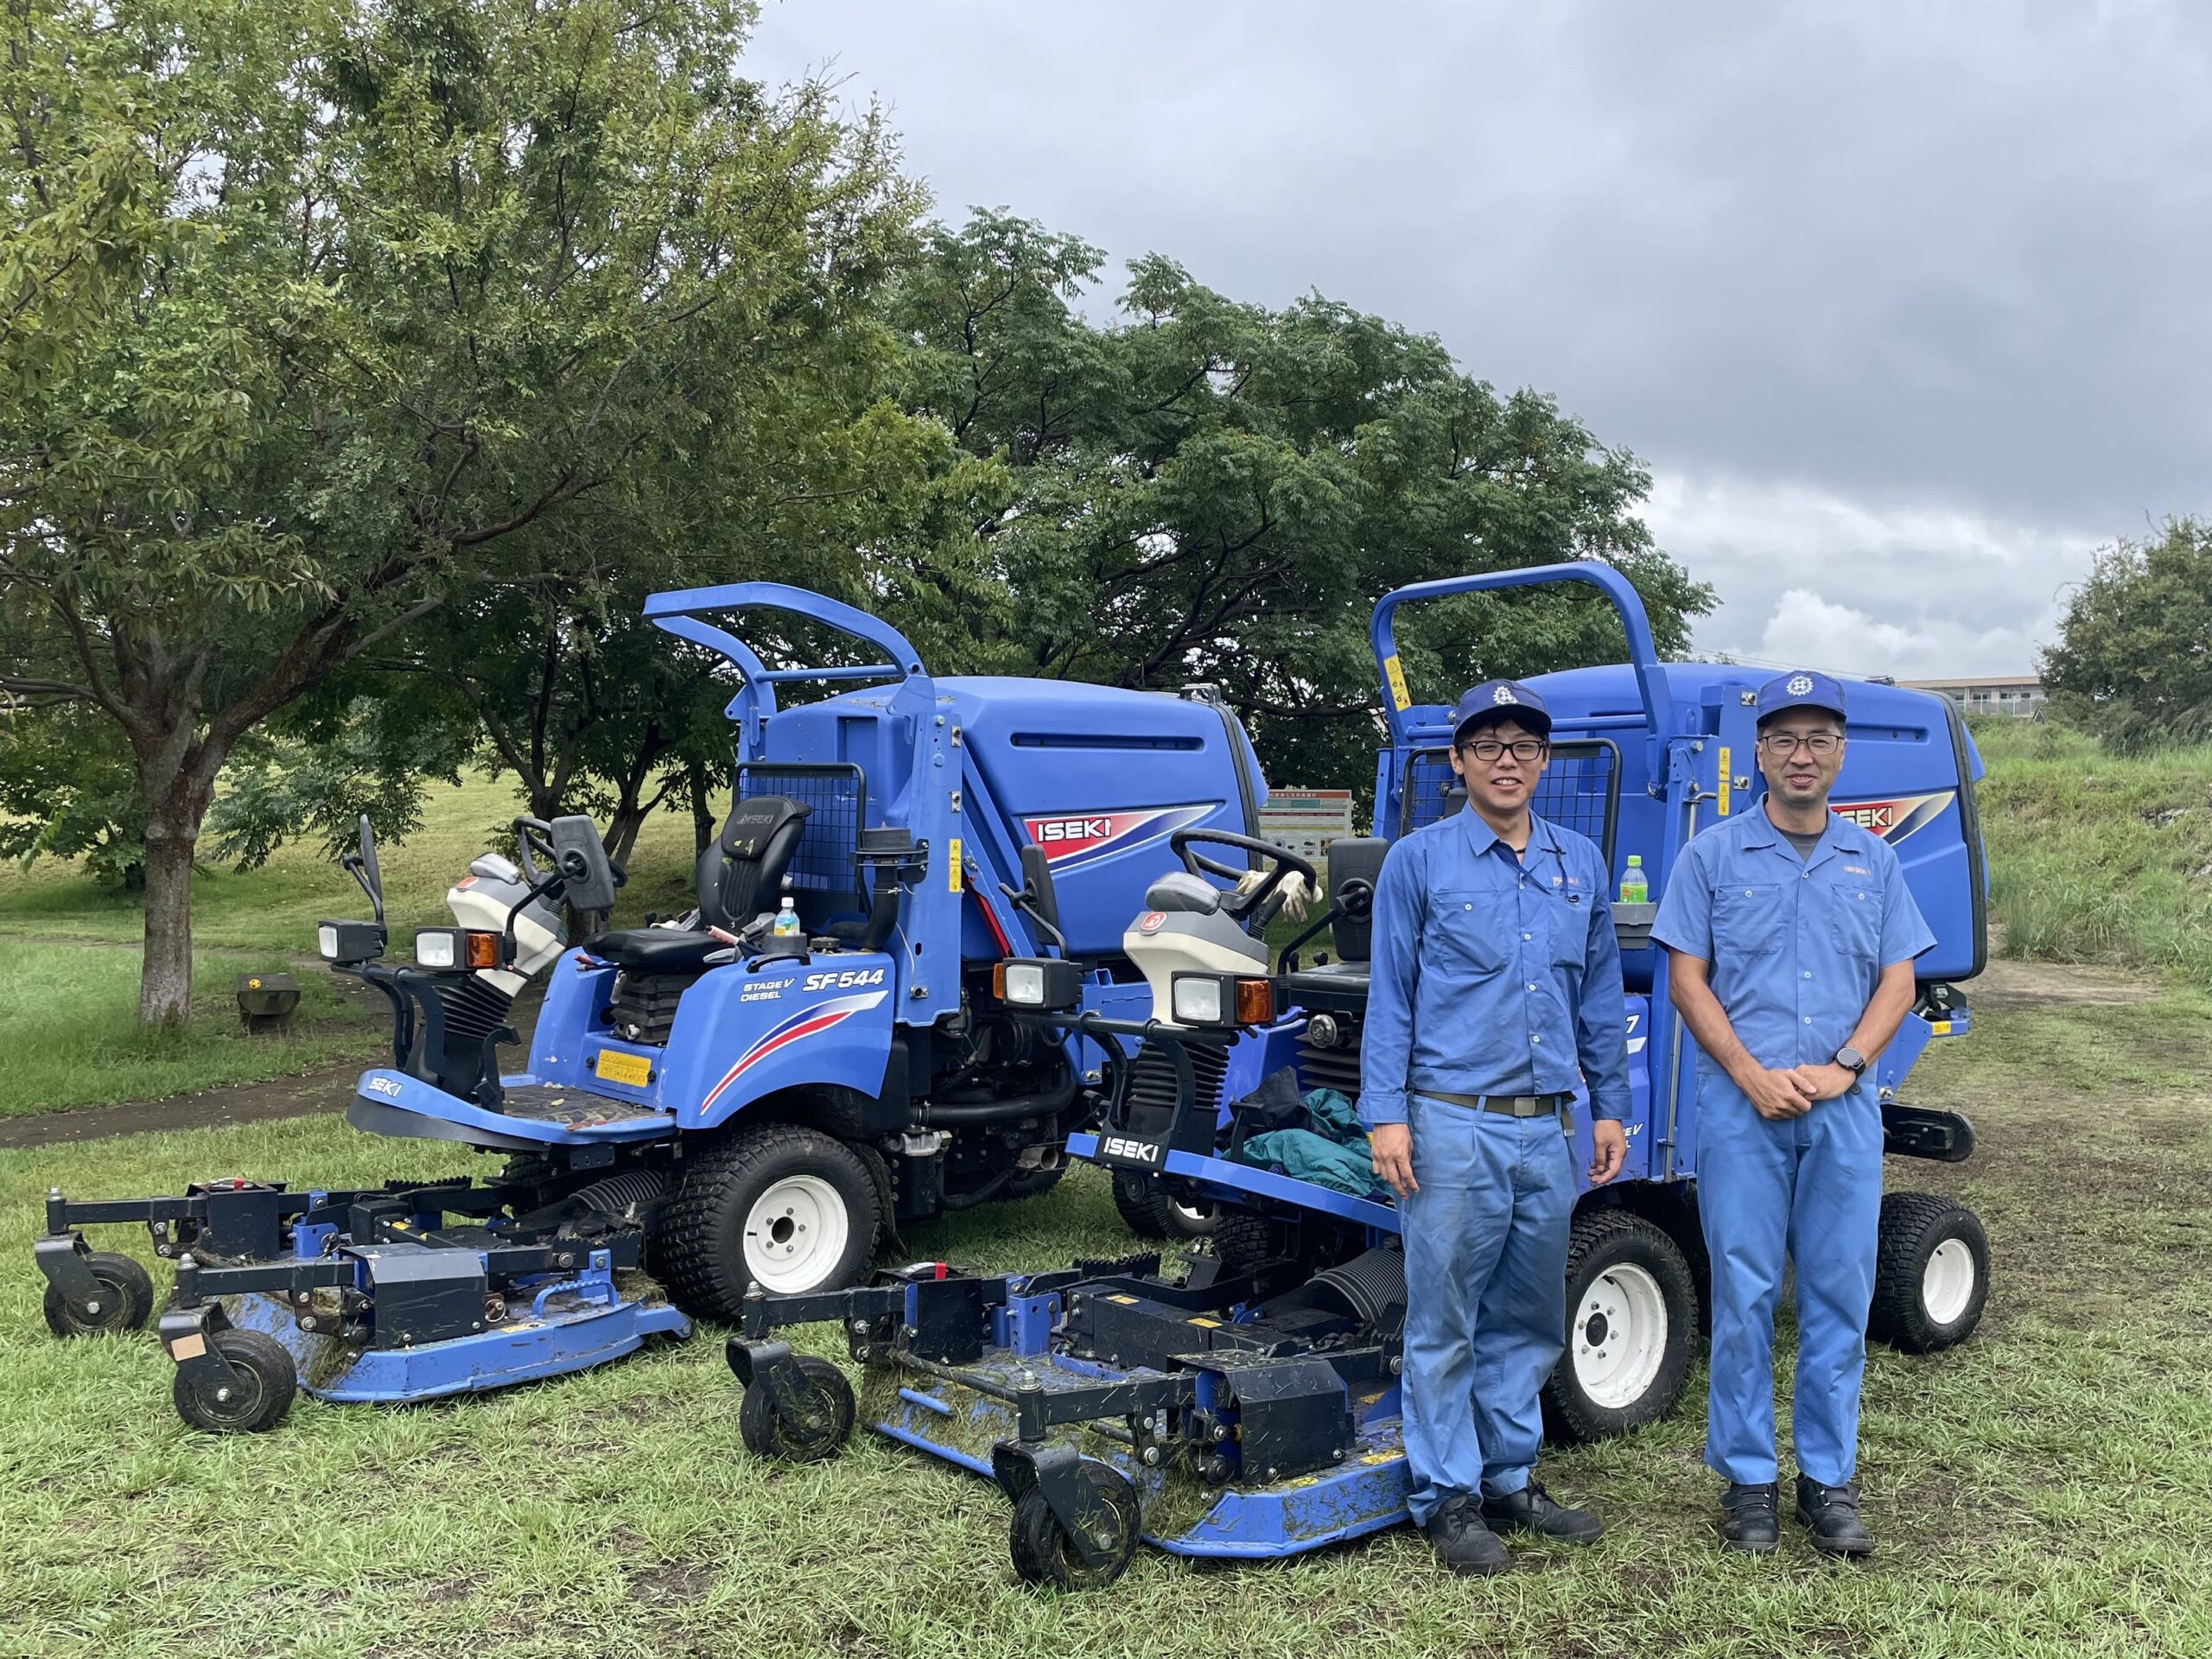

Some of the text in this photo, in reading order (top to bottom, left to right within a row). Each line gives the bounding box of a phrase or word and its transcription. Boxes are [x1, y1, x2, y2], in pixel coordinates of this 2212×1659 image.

[1837, 805, 1893, 829] SEKI
[1038, 818, 1111, 842] ISEKI
[740, 991, 782, 1002] DIESEL
[1103, 1136, 1159, 1162] ISEKI
